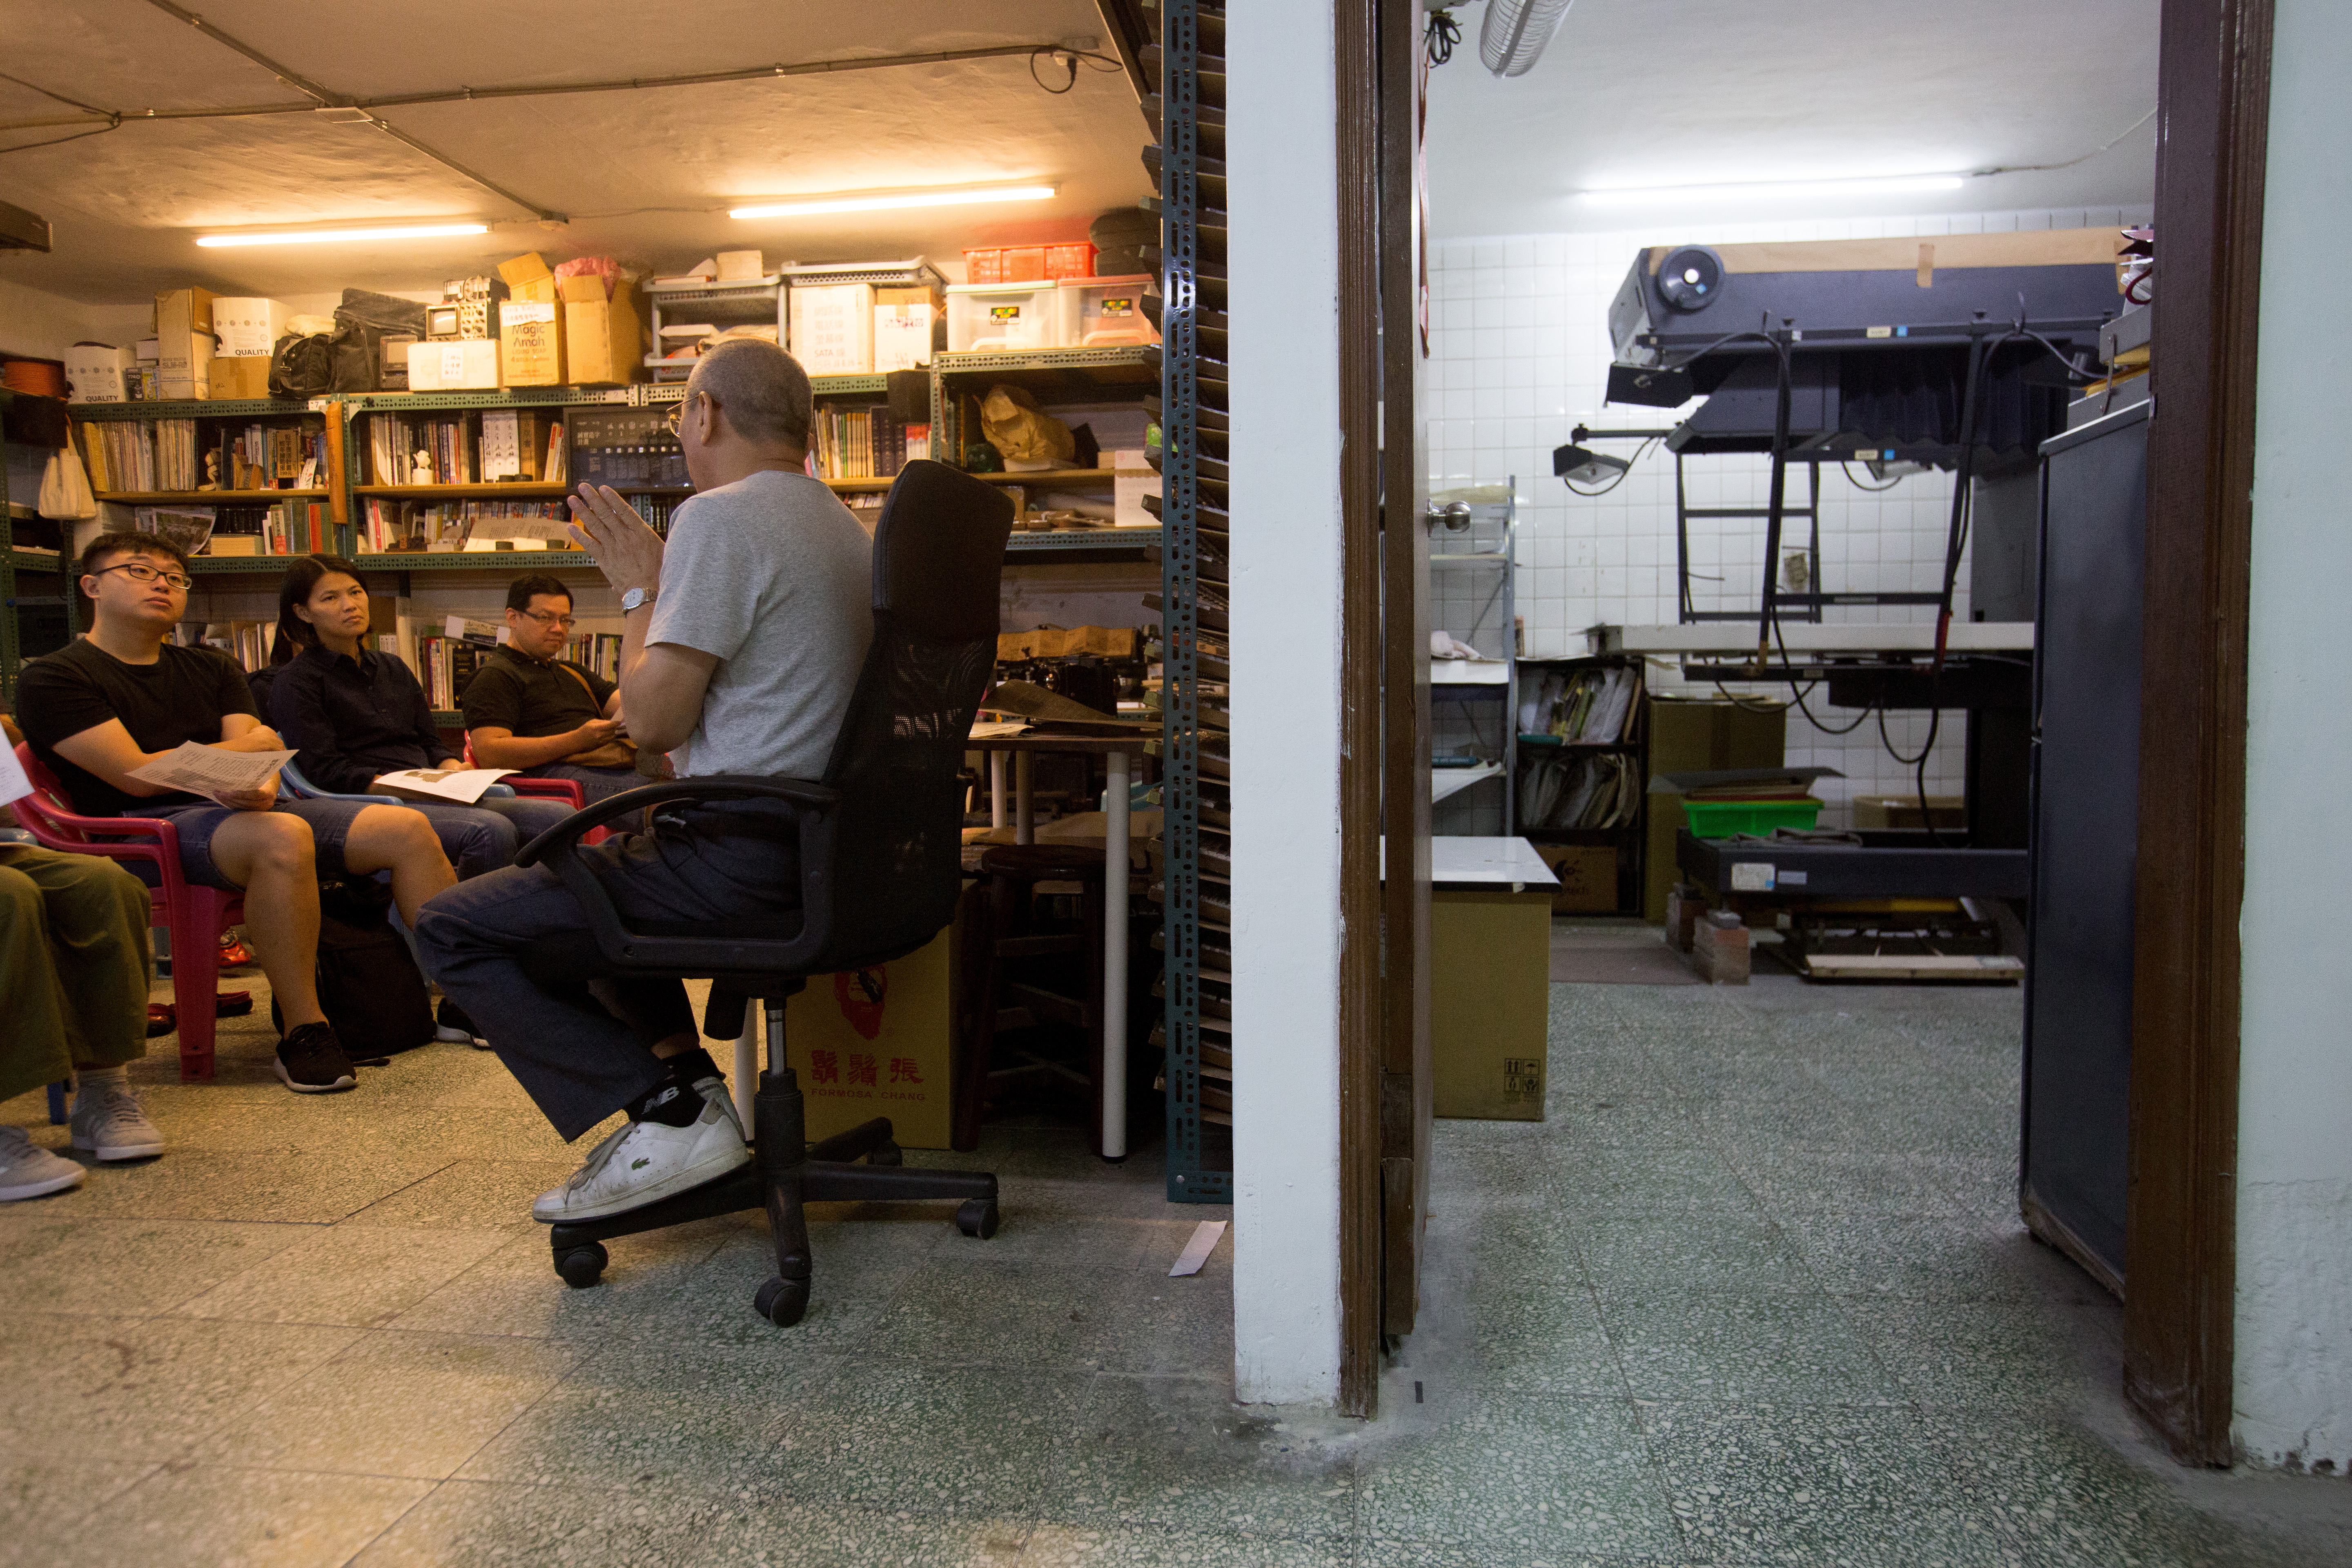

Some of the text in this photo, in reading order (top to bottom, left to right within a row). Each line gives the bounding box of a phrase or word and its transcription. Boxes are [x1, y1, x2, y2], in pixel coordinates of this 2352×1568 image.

[512, 323, 545, 336] Magic
[514, 336, 545, 346] Amah
[696, 1083, 720, 1093] acoste
[811, 1088, 925, 1101] FORMOSA CHANG
